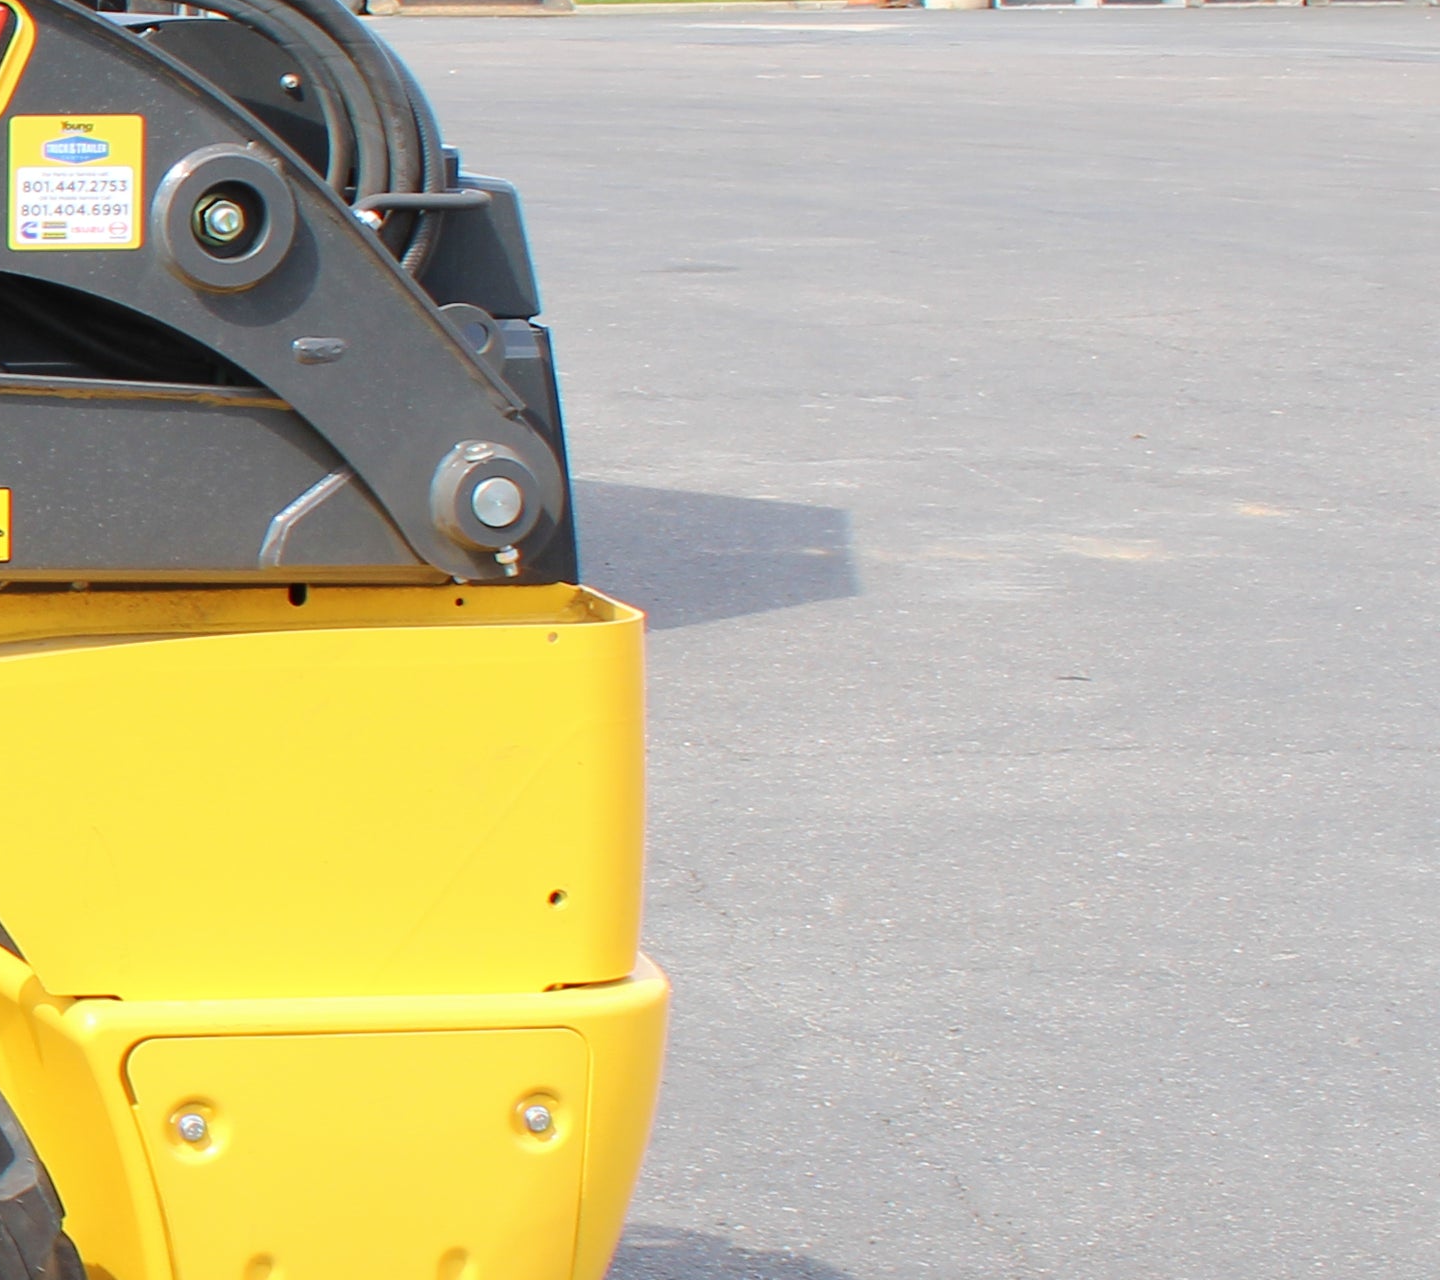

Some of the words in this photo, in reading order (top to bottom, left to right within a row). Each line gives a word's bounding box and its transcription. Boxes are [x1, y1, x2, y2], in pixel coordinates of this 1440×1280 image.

[61, 120, 95, 133] Young
[22, 180, 128, 193] 801.447.2753
[21, 204, 129, 217] 801.404.6991
